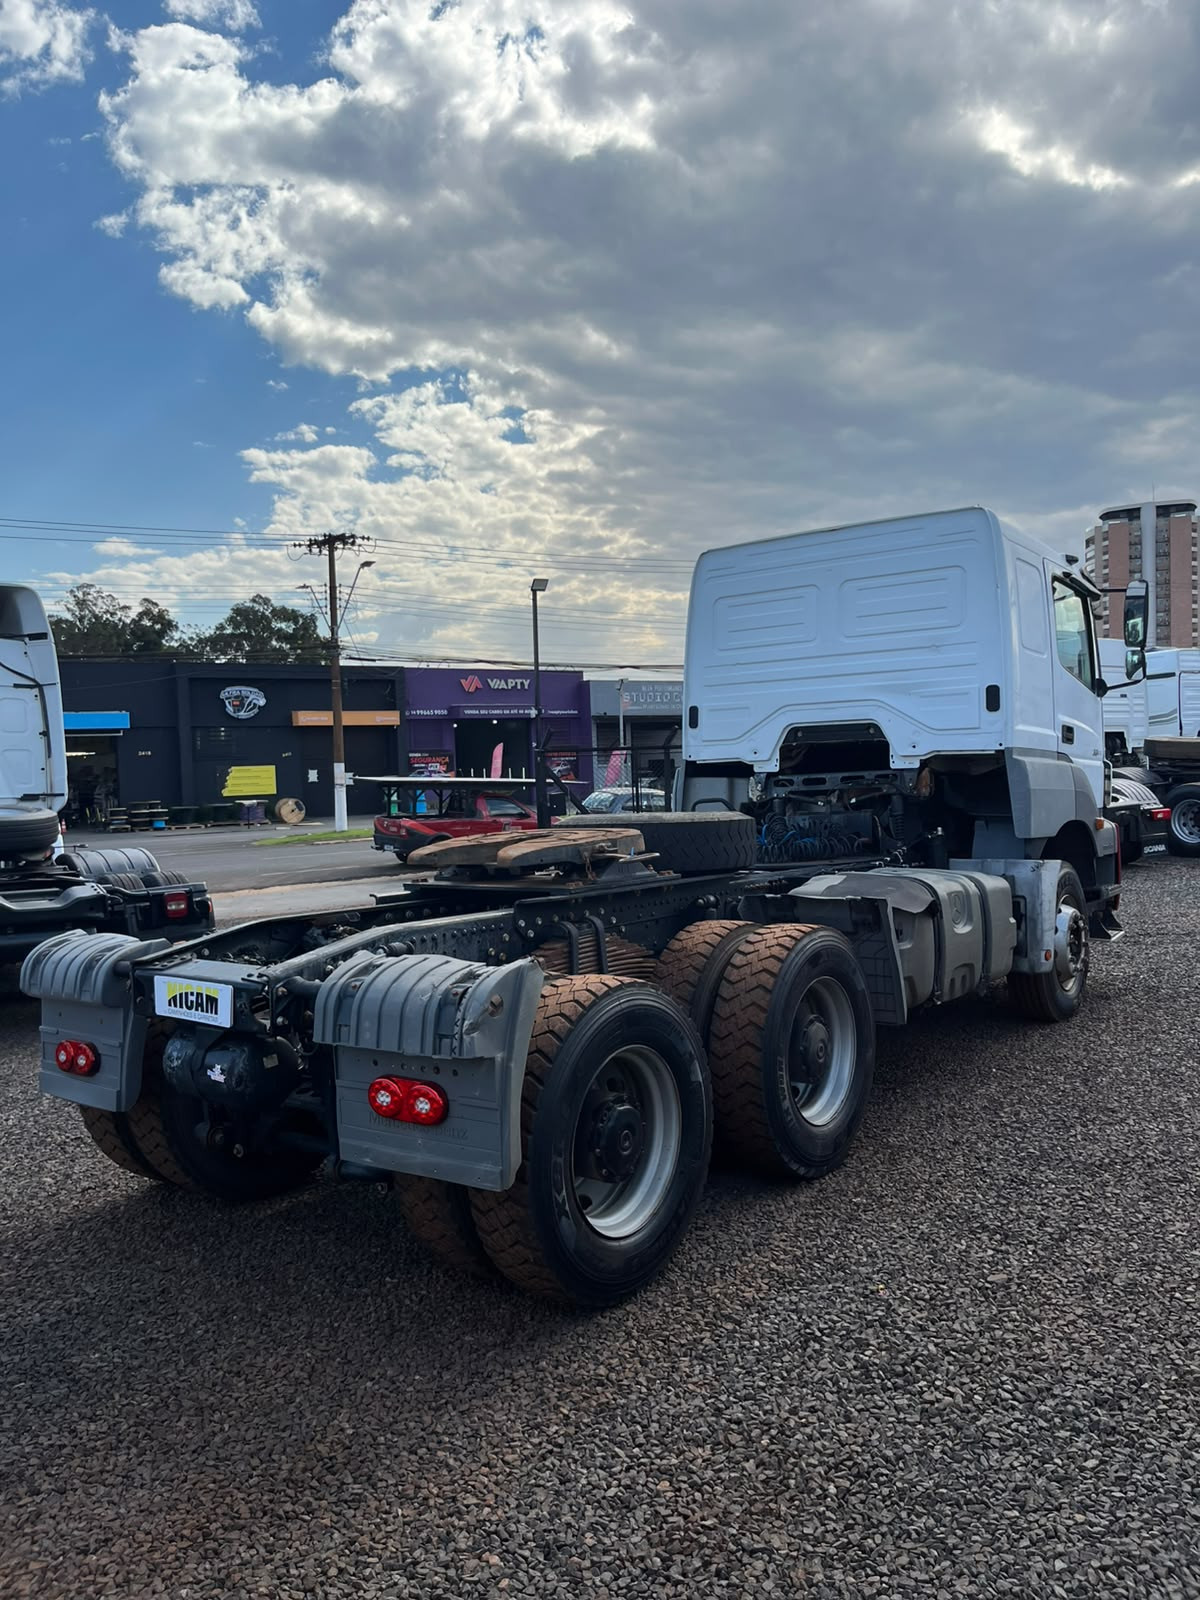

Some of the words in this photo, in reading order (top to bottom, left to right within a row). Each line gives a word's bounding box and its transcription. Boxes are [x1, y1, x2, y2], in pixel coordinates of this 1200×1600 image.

[487, 678, 530, 690] VAPTY
[623, 692, 671, 702] STUDIO
[410, 756, 449, 764] SEGURANÇA
[1143, 844, 1166, 854] SCANIA
[167, 981, 219, 1016] NICAM
